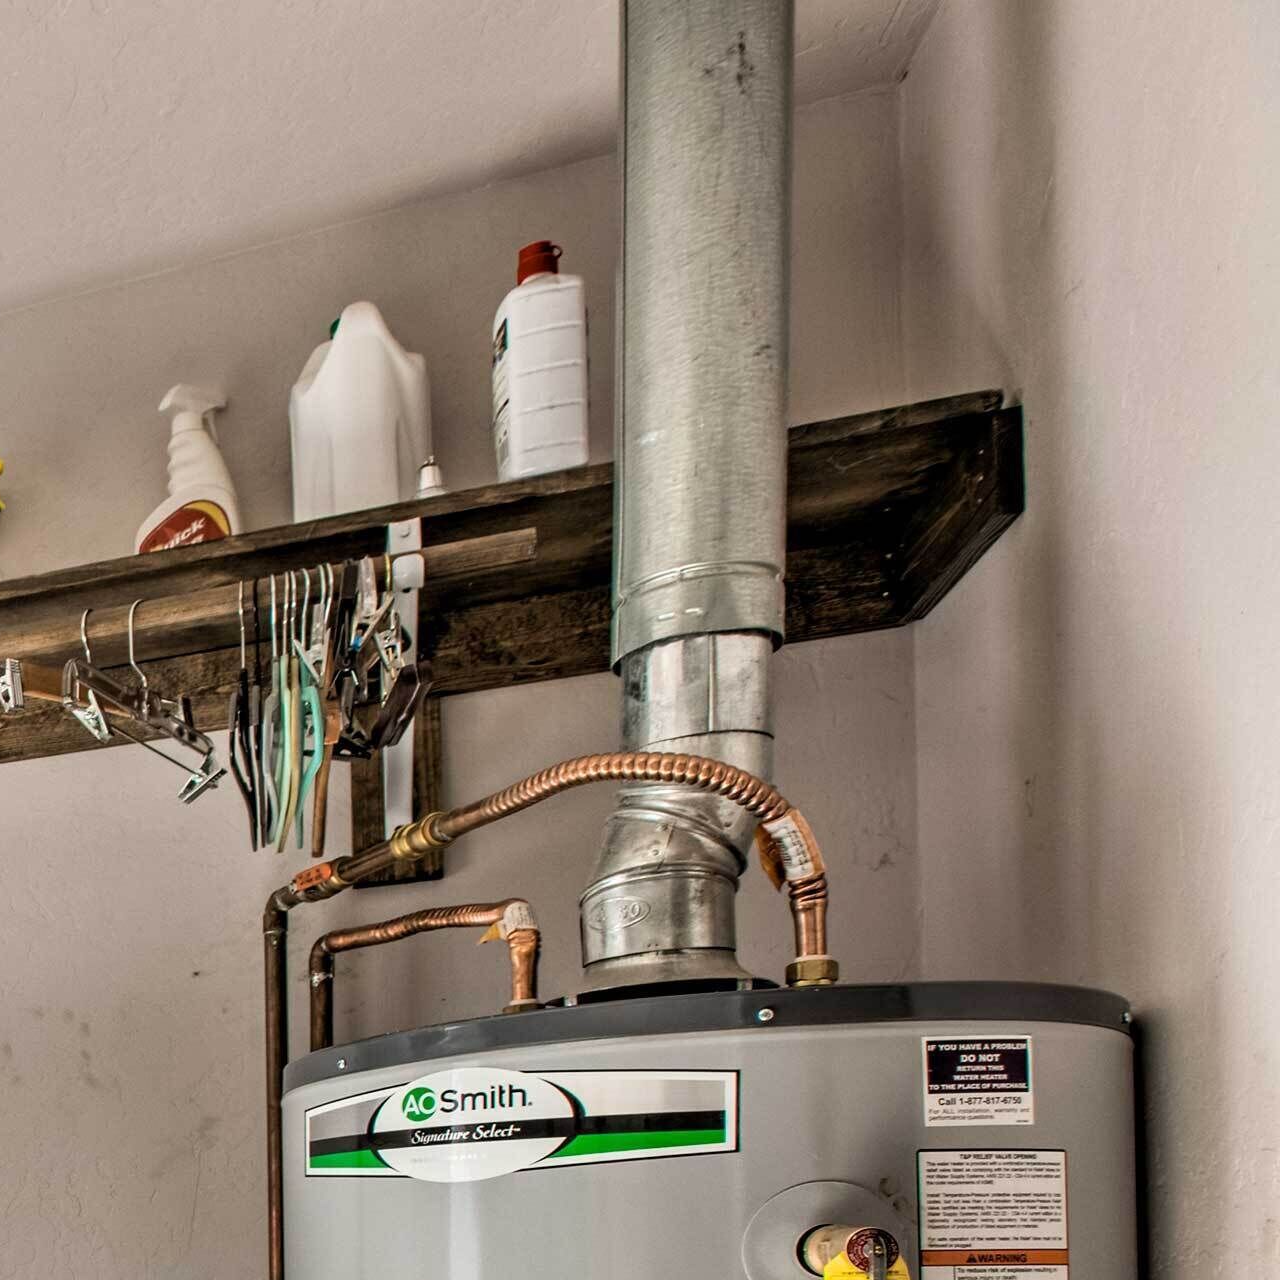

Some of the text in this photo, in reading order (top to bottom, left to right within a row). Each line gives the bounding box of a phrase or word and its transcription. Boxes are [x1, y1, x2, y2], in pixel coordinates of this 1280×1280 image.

[959, 1043, 982, 1051] HAVE
[960, 1053, 1001, 1063] DO NOT
[440, 1083, 527, 1113] Smith
[938, 1097, 956, 1105] Call
[411, 1125, 470, 1145] Signature
[978, 1253, 1028, 1263] WARNING
